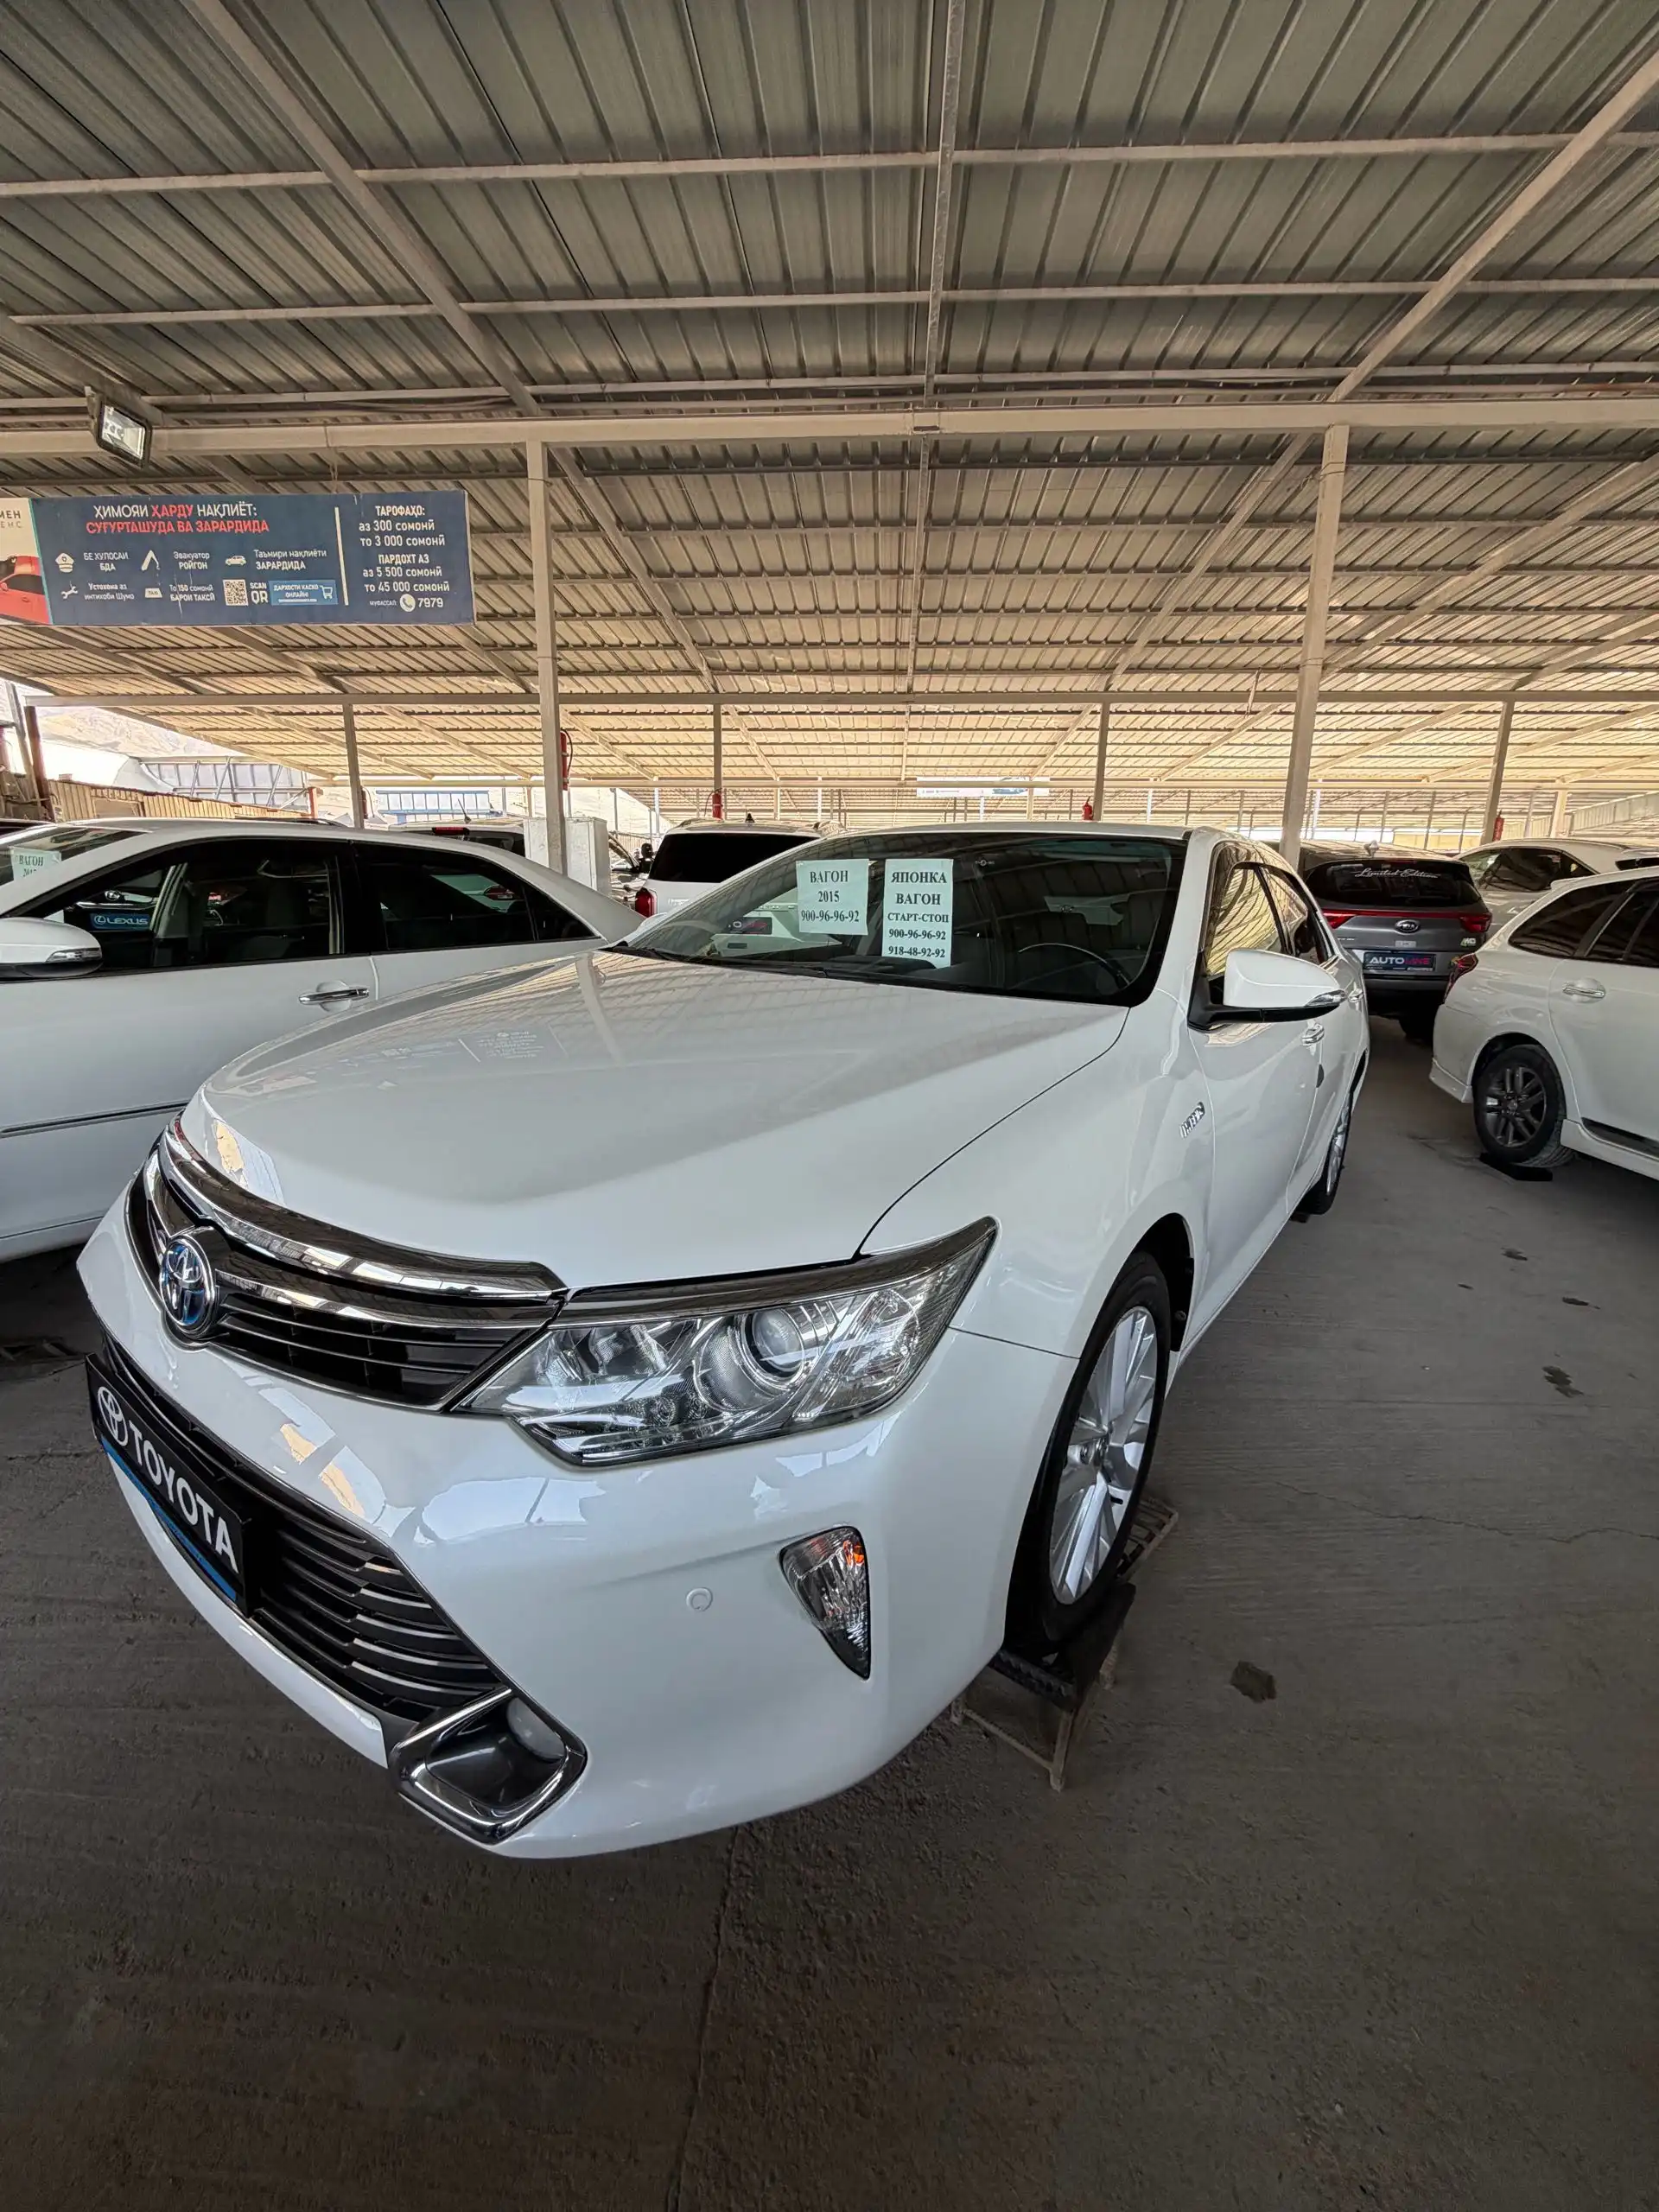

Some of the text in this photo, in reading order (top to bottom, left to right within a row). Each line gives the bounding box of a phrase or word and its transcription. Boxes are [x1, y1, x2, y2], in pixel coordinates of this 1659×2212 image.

[177, 521, 194, 532] ВА
[196, 519, 270, 533] ЗАРАРДИДА
[359, 523, 371, 532] аз
[373, 519, 393, 531] 300
[359, 537, 372, 547] то
[375, 535, 382, 547] 3
[384, 535, 404, 546] 000
[255, 560, 307, 571] ЗАРАРДИДА
[378, 553, 430, 566] ПАРДОХТ АЗ
[362, 569, 374, 578] аз
[376, 567, 383, 577] 5
[385, 566, 404, 577] 500
[249, 582, 266, 590] SCAN
[364, 583, 376, 593] то
[378, 581, 391, 593] 45
[392, 581, 410, 592] 000
[251, 590, 269, 604] QR
[417, 597, 443, 608] 7979
[19, 855, 43, 867] ВАГОН
[810, 870, 849, 884] ВАГОН
[891, 871, 948, 884] ЯПОНКА
[817, 890, 840, 903] 2015
[896, 893, 941, 906] ВАГОН
[106, 917, 149, 925] LEXUS
[800, 909, 860, 923] 900-96-96-92
[887, 912, 949, 923] СТАРТ-СТОП
[888, 928, 946, 940] 900-96-96-92
[888, 945, 946, 958] 918-48-92-92
[128, 1420, 239, 1573] TOYOTA
